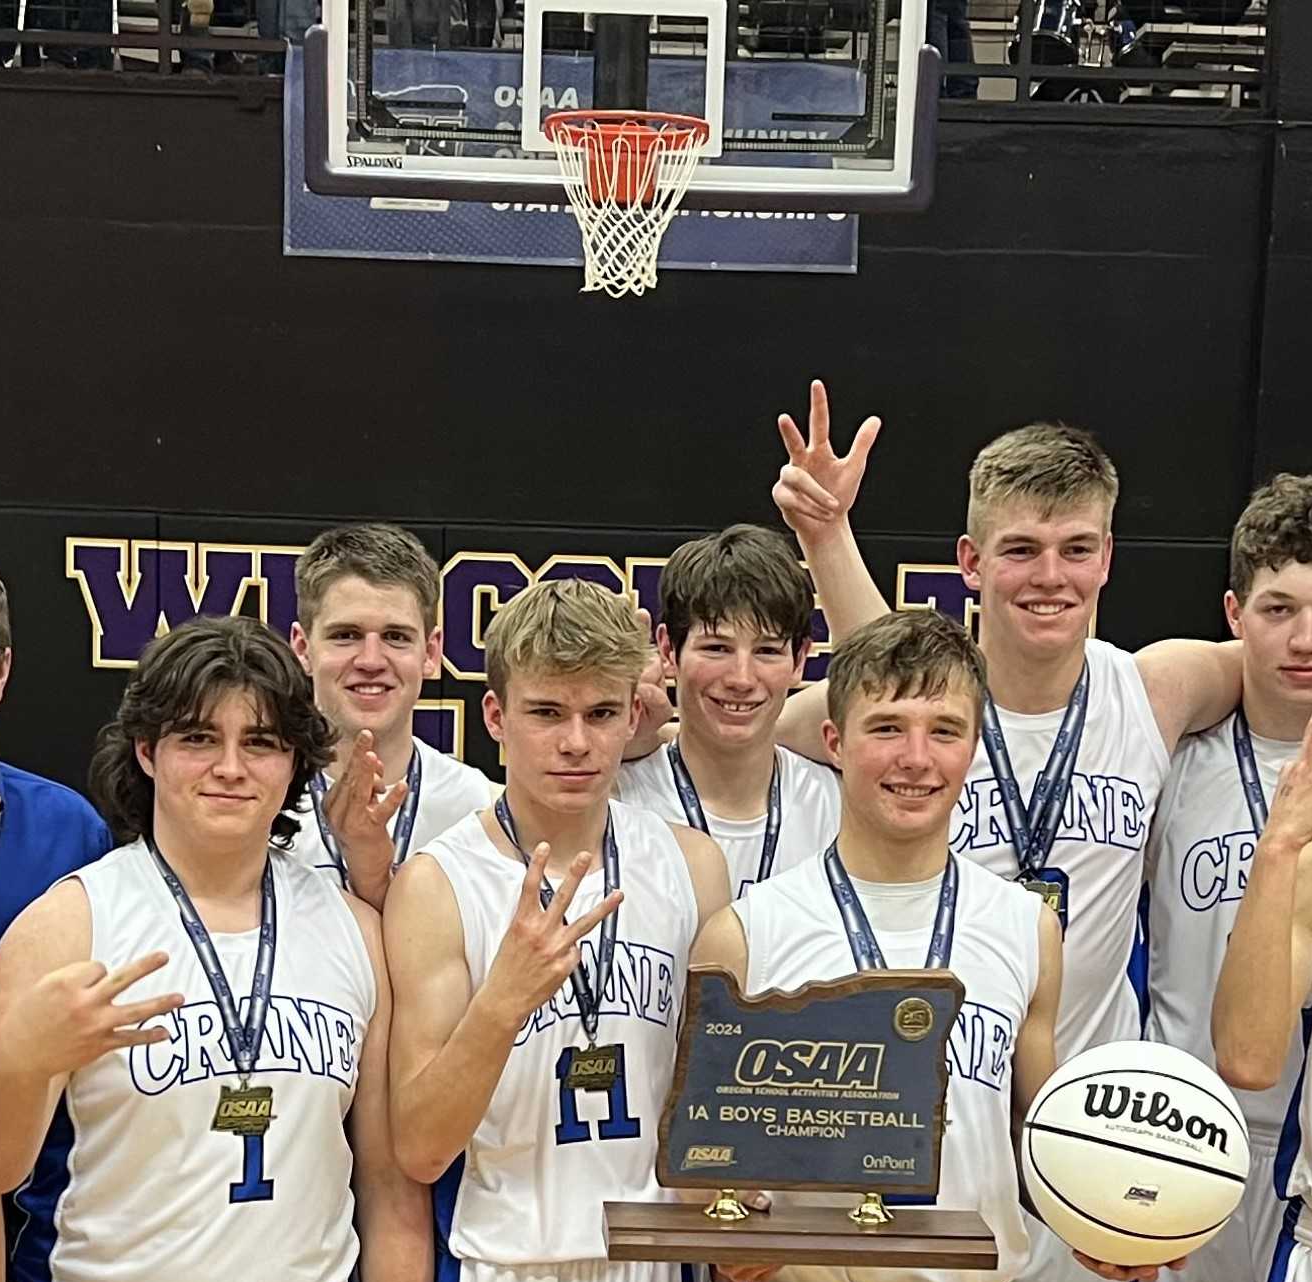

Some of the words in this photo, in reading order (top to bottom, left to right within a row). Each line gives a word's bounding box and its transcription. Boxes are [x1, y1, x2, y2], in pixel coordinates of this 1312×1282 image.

[346, 155, 403, 169] SPALDING
[706, 1023, 742, 1036] 2024
[571, 1058, 616, 1075] OSAA
[735, 1039, 885, 1091] OSAA
[716, 1085, 754, 1096] OREGON
[755, 1086, 789, 1097] SCHOOL
[791, 1088, 840, 1099] ACTIVITIES
[841, 1090, 900, 1101] ASSOCIATION
[219, 1100, 270, 1117] OSAA
[688, 1104, 709, 1121] 1A
[720, 1105, 776, 1123] BOYS
[787, 1109, 925, 1128] BASKETBALL
[1084, 1083, 1230, 1155] Wilson
[765, 1124, 846, 1139] CHAMPION
[863, 1154, 915, 1169] OnPoint
